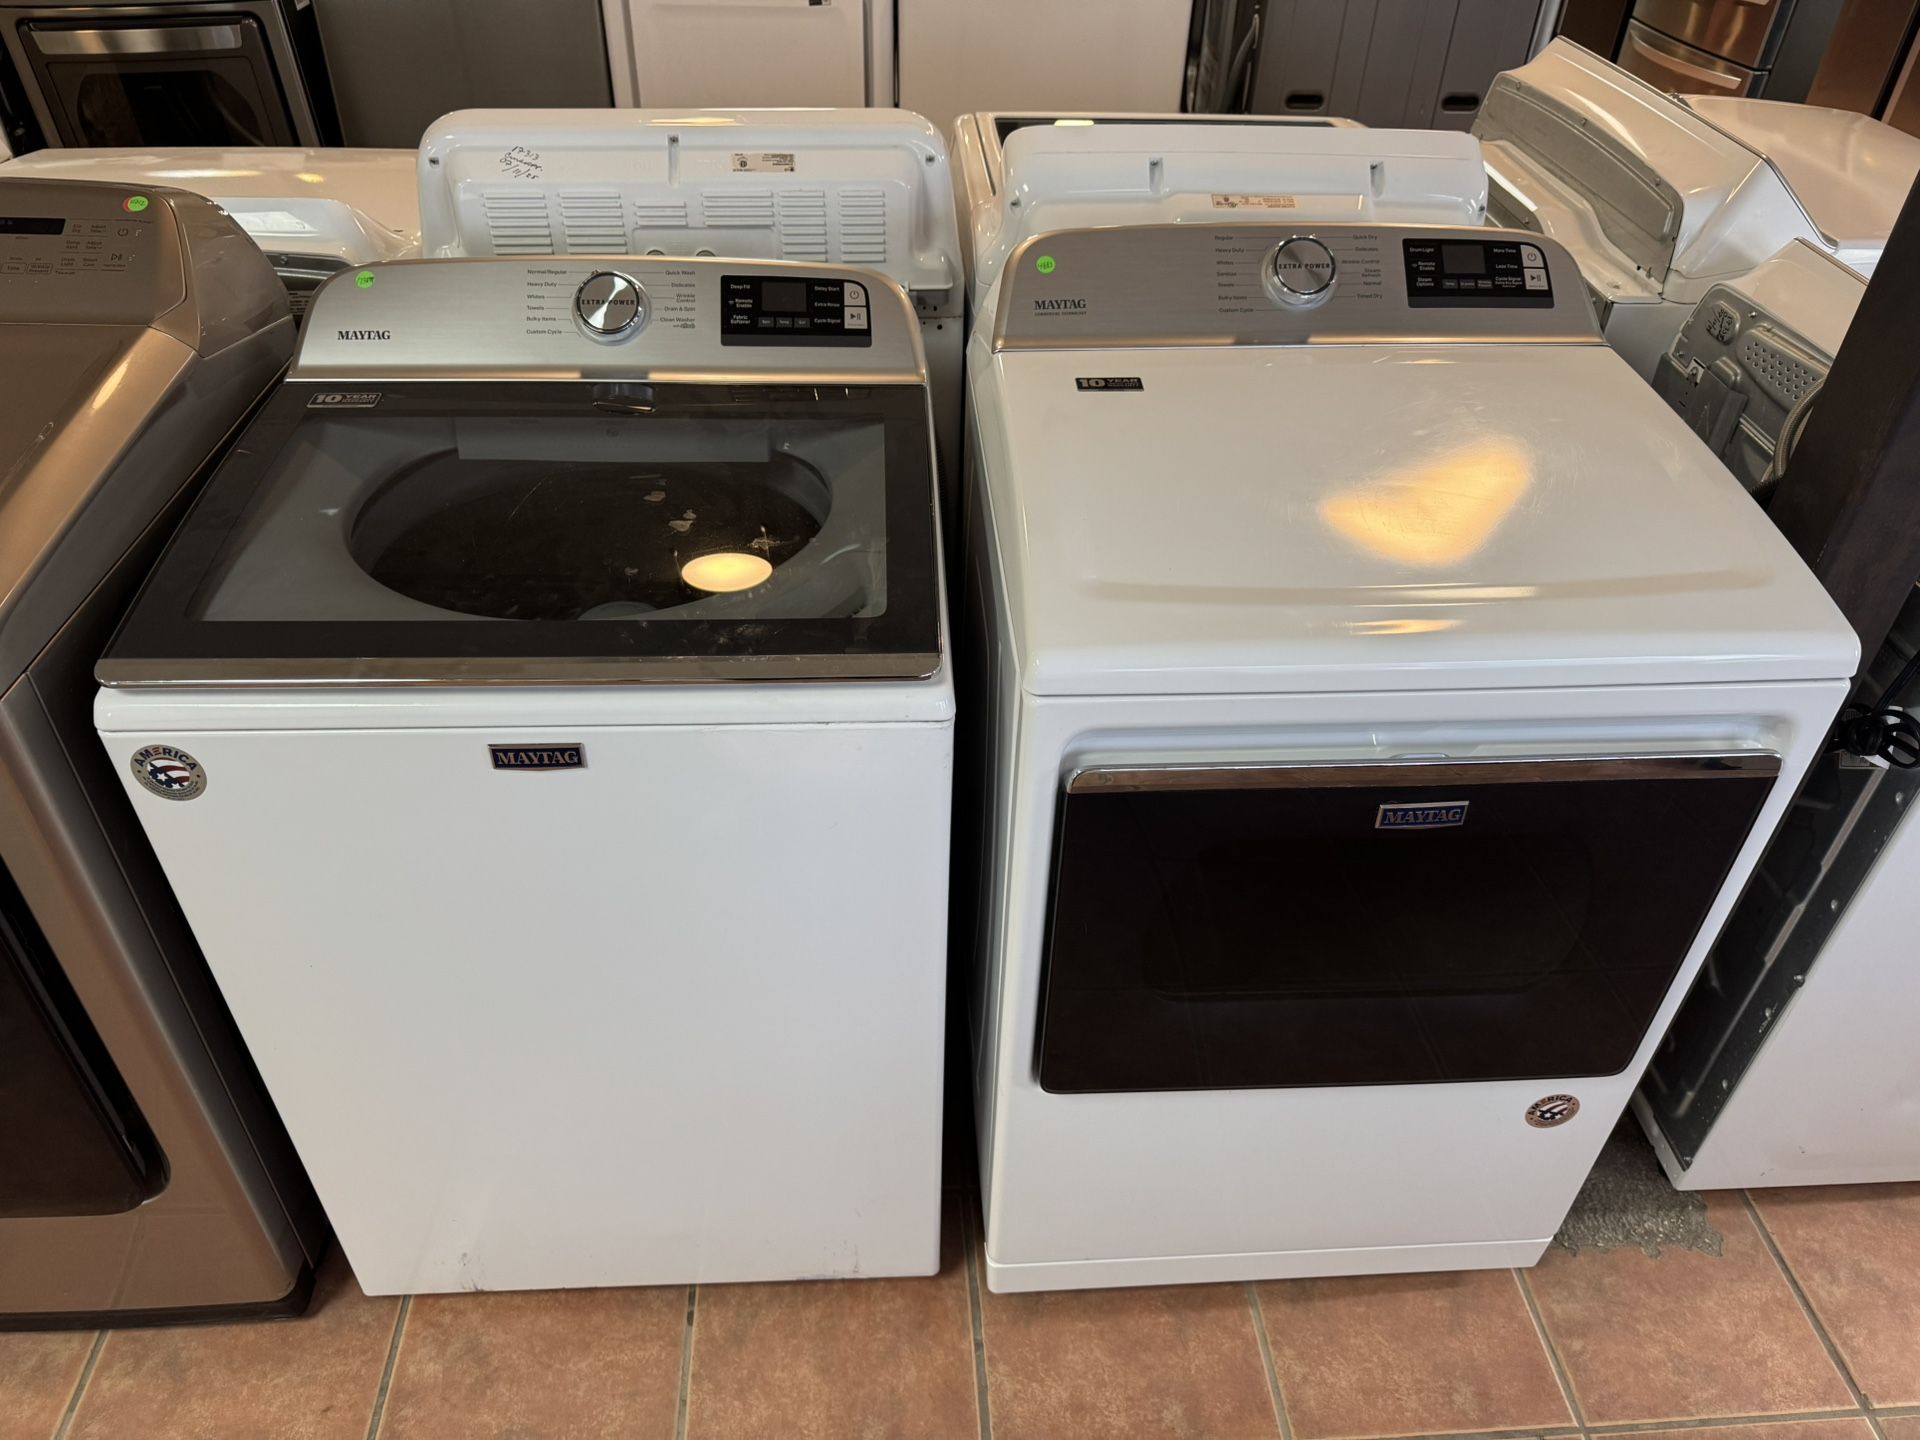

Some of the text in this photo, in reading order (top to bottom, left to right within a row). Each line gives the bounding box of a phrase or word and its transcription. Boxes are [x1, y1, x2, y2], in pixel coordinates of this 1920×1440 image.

[1034, 299, 1086, 310] MAYTAG
[338, 330, 391, 340] MAYTAG
[1080, 379, 1105, 387] 10
[316, 394, 343, 403] 10
[134, 746, 197, 770] AMERICA
[496, 751, 578, 764] MAYTAG
[1383, 809, 1462, 824] MAYTAG
[1528, 1095, 1572, 1115] AMERICA
